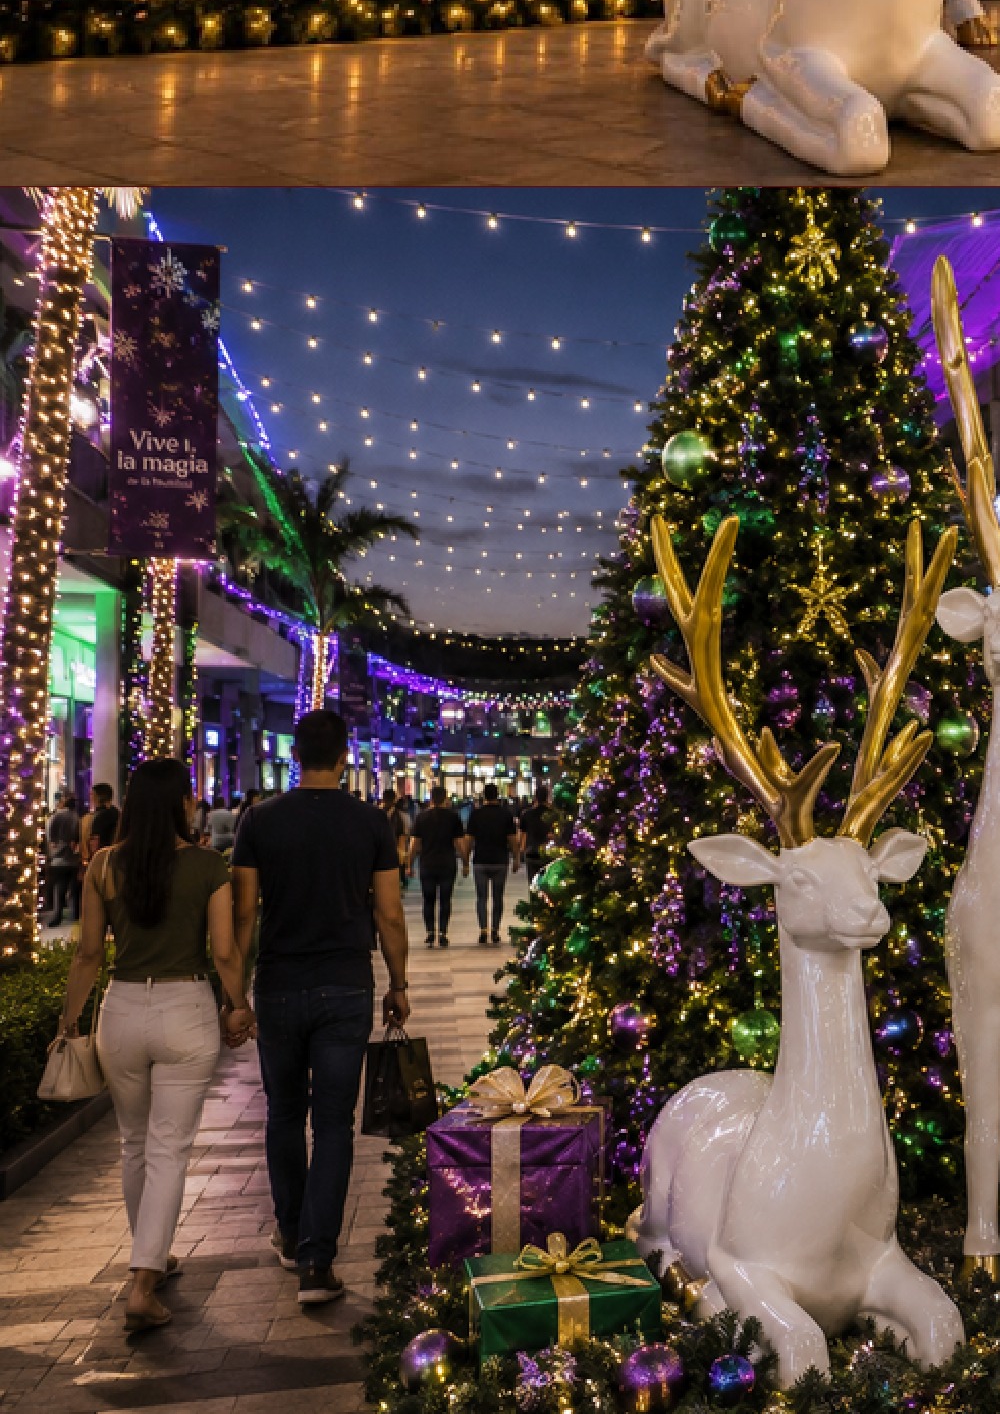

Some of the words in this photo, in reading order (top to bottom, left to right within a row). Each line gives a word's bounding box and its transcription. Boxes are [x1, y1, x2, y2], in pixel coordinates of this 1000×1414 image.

[129, 428, 179, 453] Vive
[117, 450, 136, 470] la
[142, 455, 208, 478] magia
